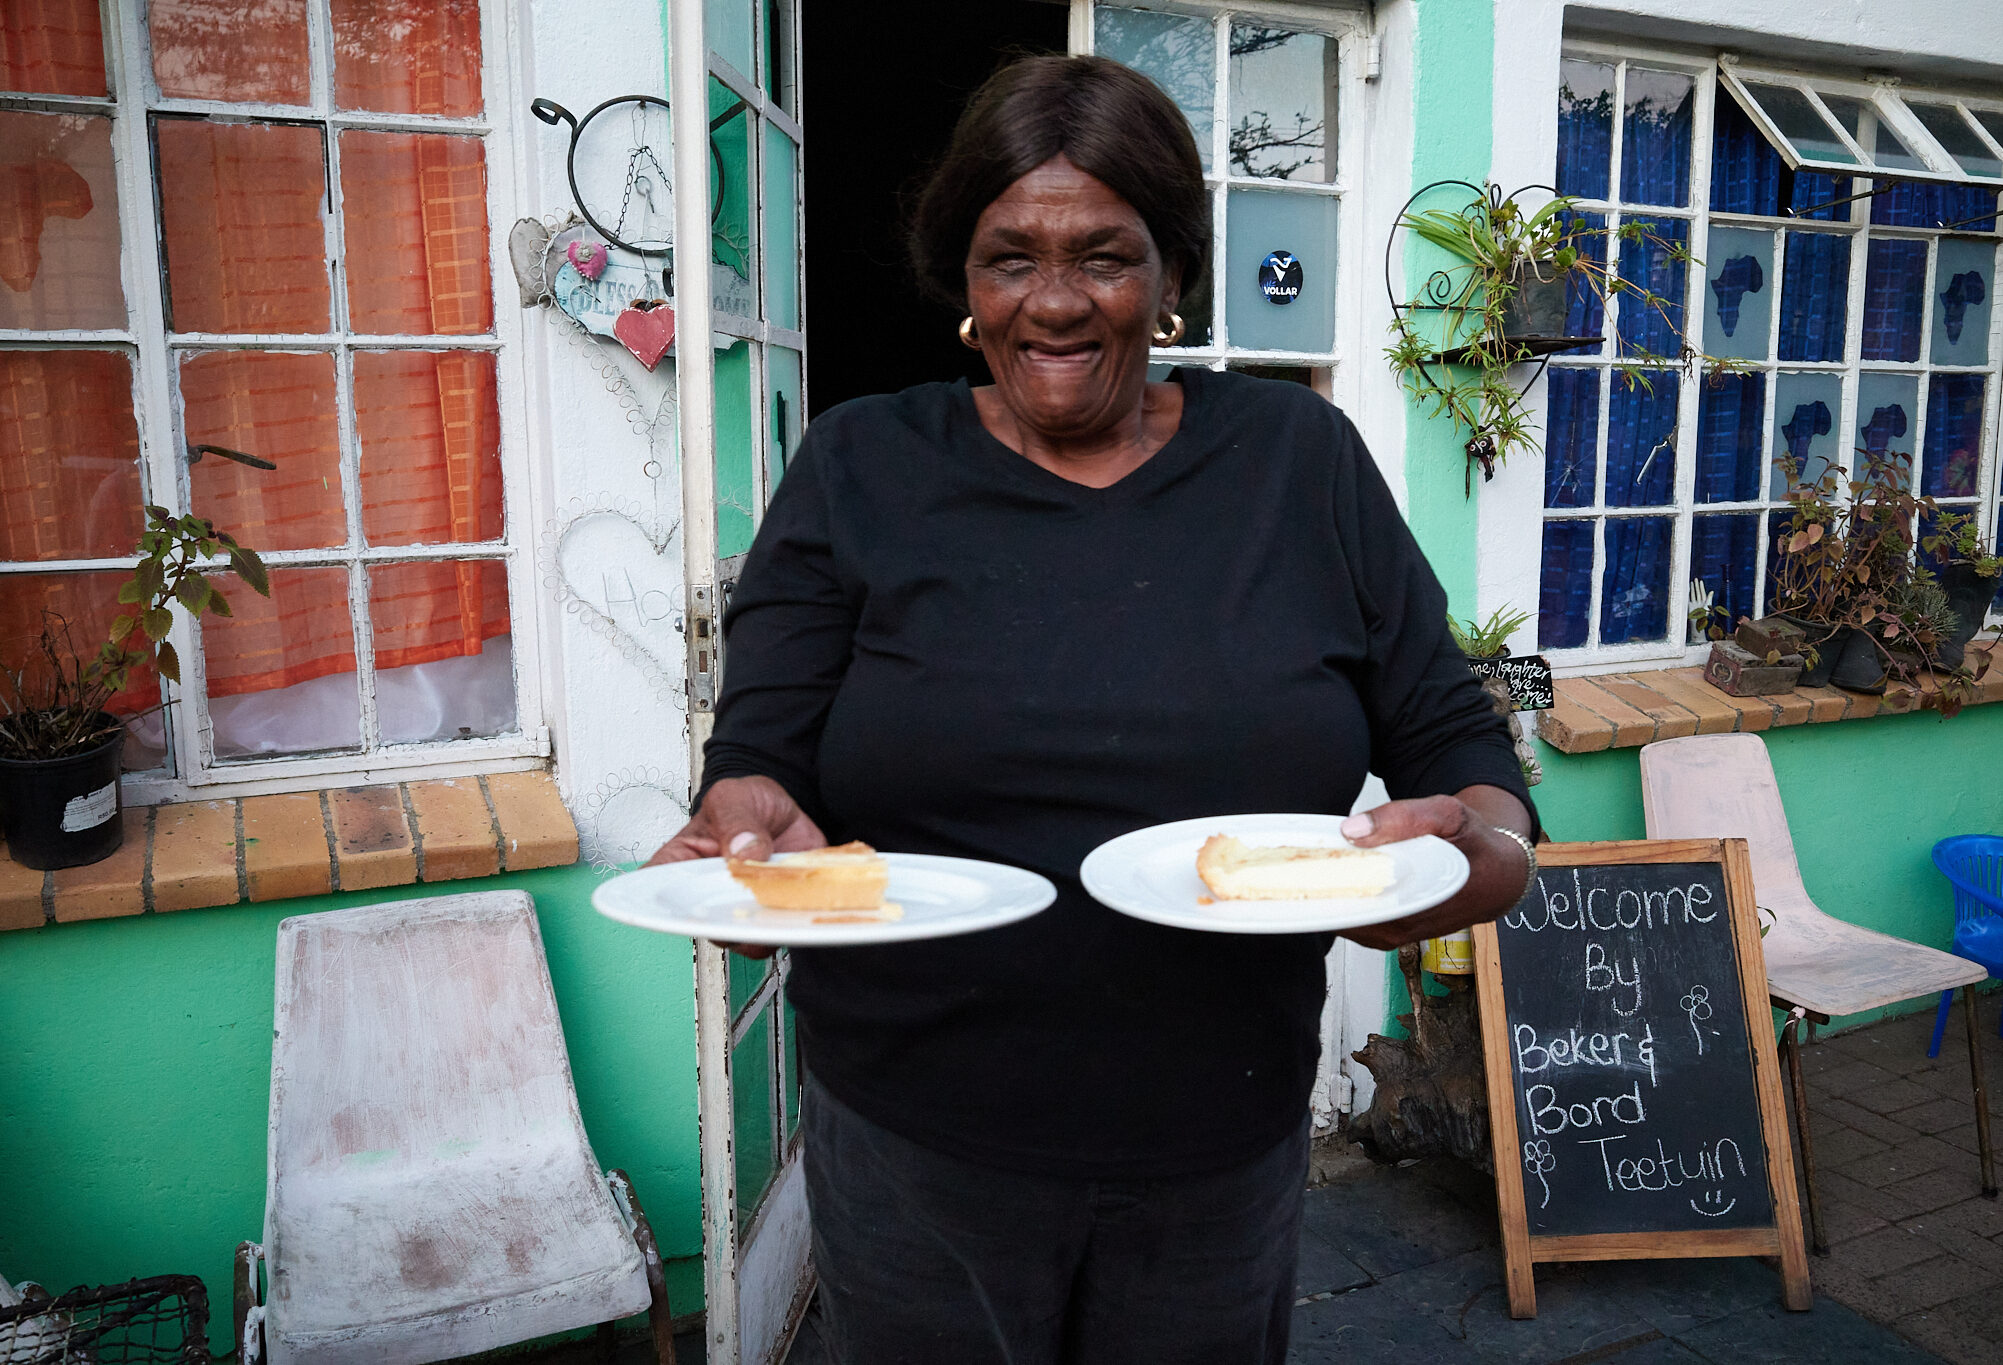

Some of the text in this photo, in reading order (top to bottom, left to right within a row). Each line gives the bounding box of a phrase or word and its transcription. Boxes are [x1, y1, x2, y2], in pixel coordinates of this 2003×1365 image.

[1263, 286, 1298, 296] VOLLAR
[1504, 868, 1718, 932] Welcome
[1585, 942, 1642, 1017] By
[1514, 1023, 1658, 1088] Beker &
[1527, 1080, 1647, 1135] Bord
[1577, 1134, 1747, 1192] Teetuin
